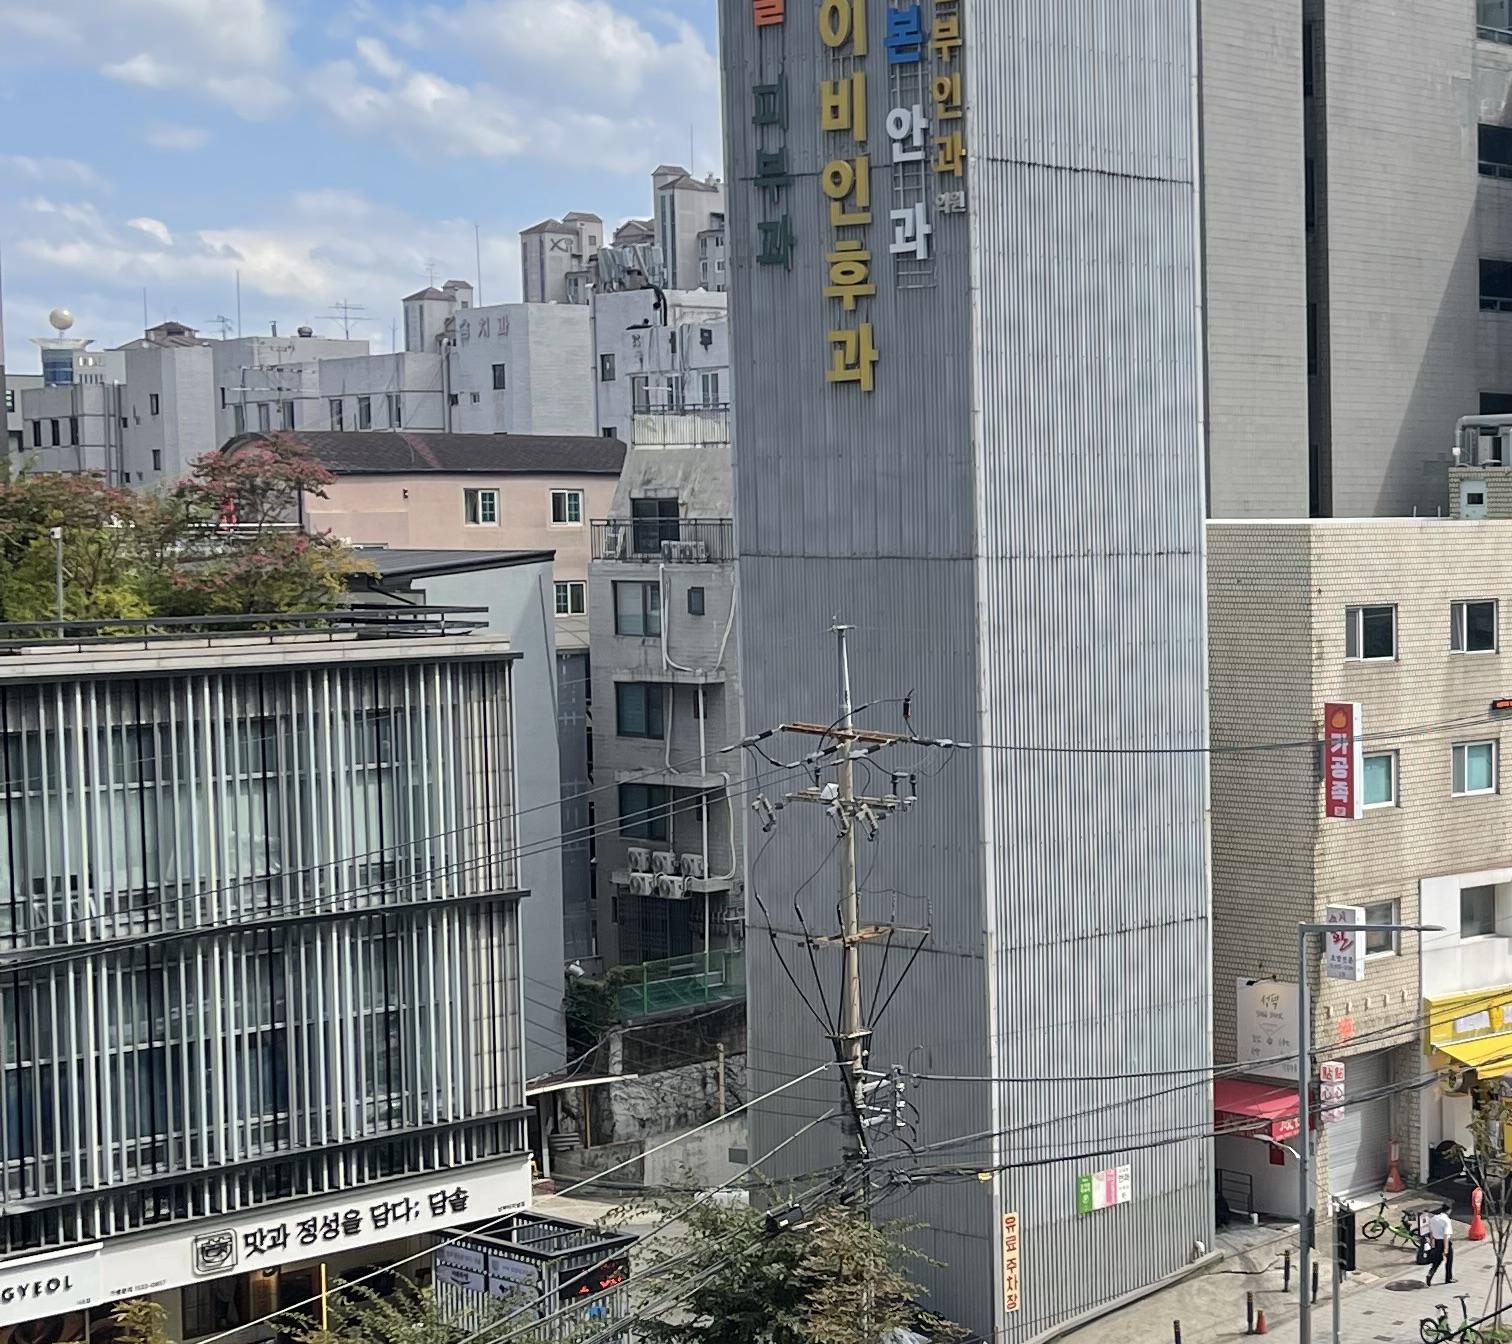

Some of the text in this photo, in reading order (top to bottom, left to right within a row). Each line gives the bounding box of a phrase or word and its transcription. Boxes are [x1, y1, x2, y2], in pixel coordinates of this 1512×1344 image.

[752, 73, 795, 272] 피부과
[244, 1222, 290, 1258] 맛과
[296, 1208, 364, 1246] 정성을
[1005, 1216, 1019, 1310] 유료 주차장
[1, 1274, 74, 1304] GYEOL
